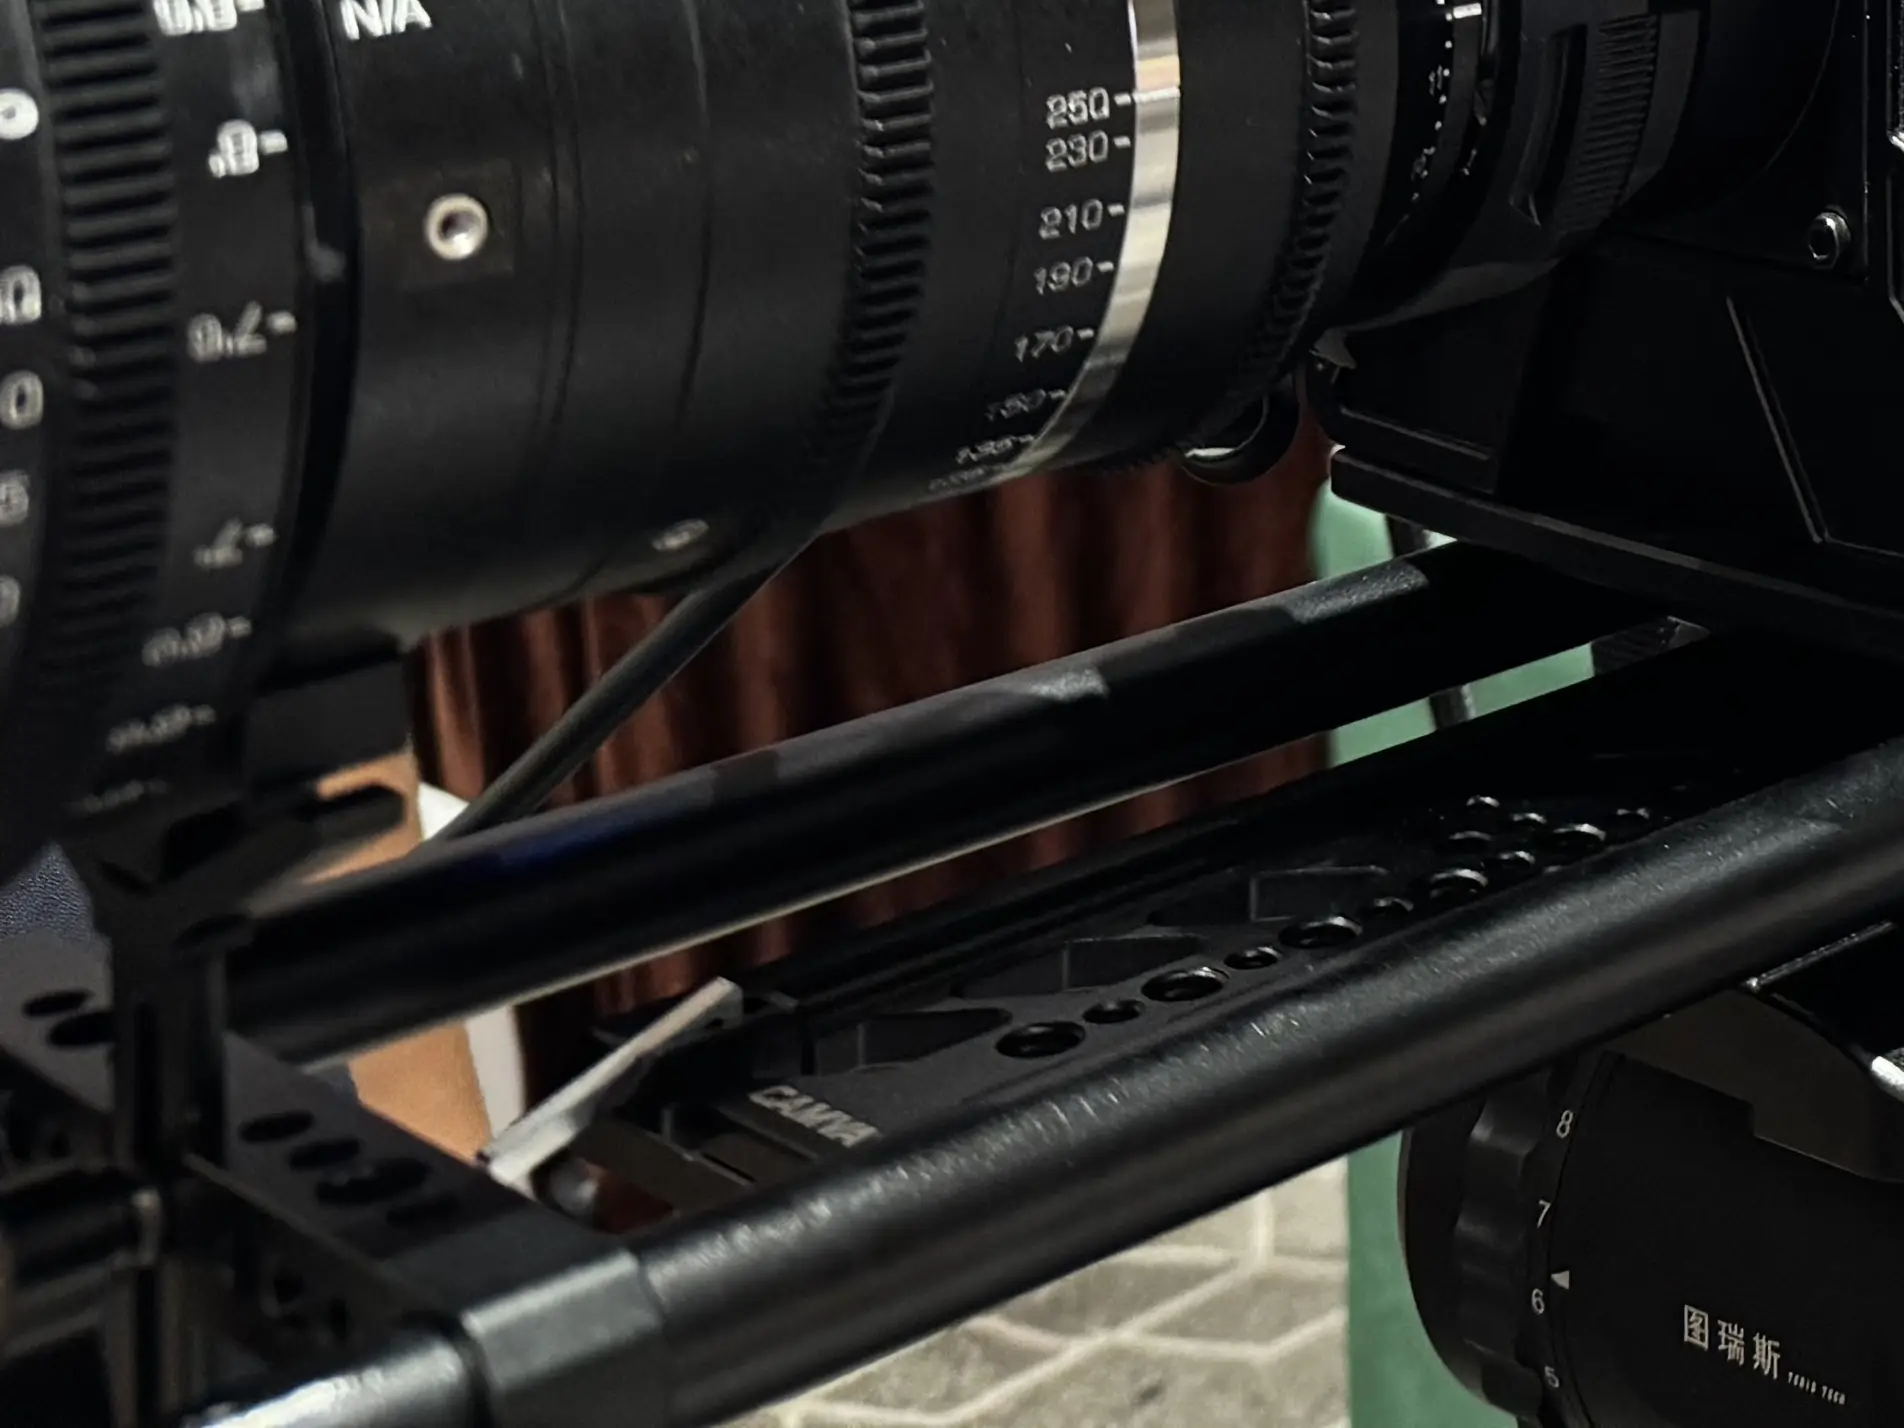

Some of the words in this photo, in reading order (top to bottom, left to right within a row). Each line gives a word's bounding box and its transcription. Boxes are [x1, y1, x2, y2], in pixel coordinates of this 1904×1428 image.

[1046, 87, 1111, 130] 250
[1045, 129, 1109, 173] 230
[1038, 198, 1104, 241] 210
[1033, 256, 1094, 296] 190
[1014, 324, 1075, 363] 170
[1555, 1109, 1575, 1139] 8
[1536, 1199, 1553, 1229] 7
[1531, 1287, 1545, 1315] 6
[1683, 1303, 1781, 1381] 图瑞斯
[1544, 1365, 1560, 1390] 5
